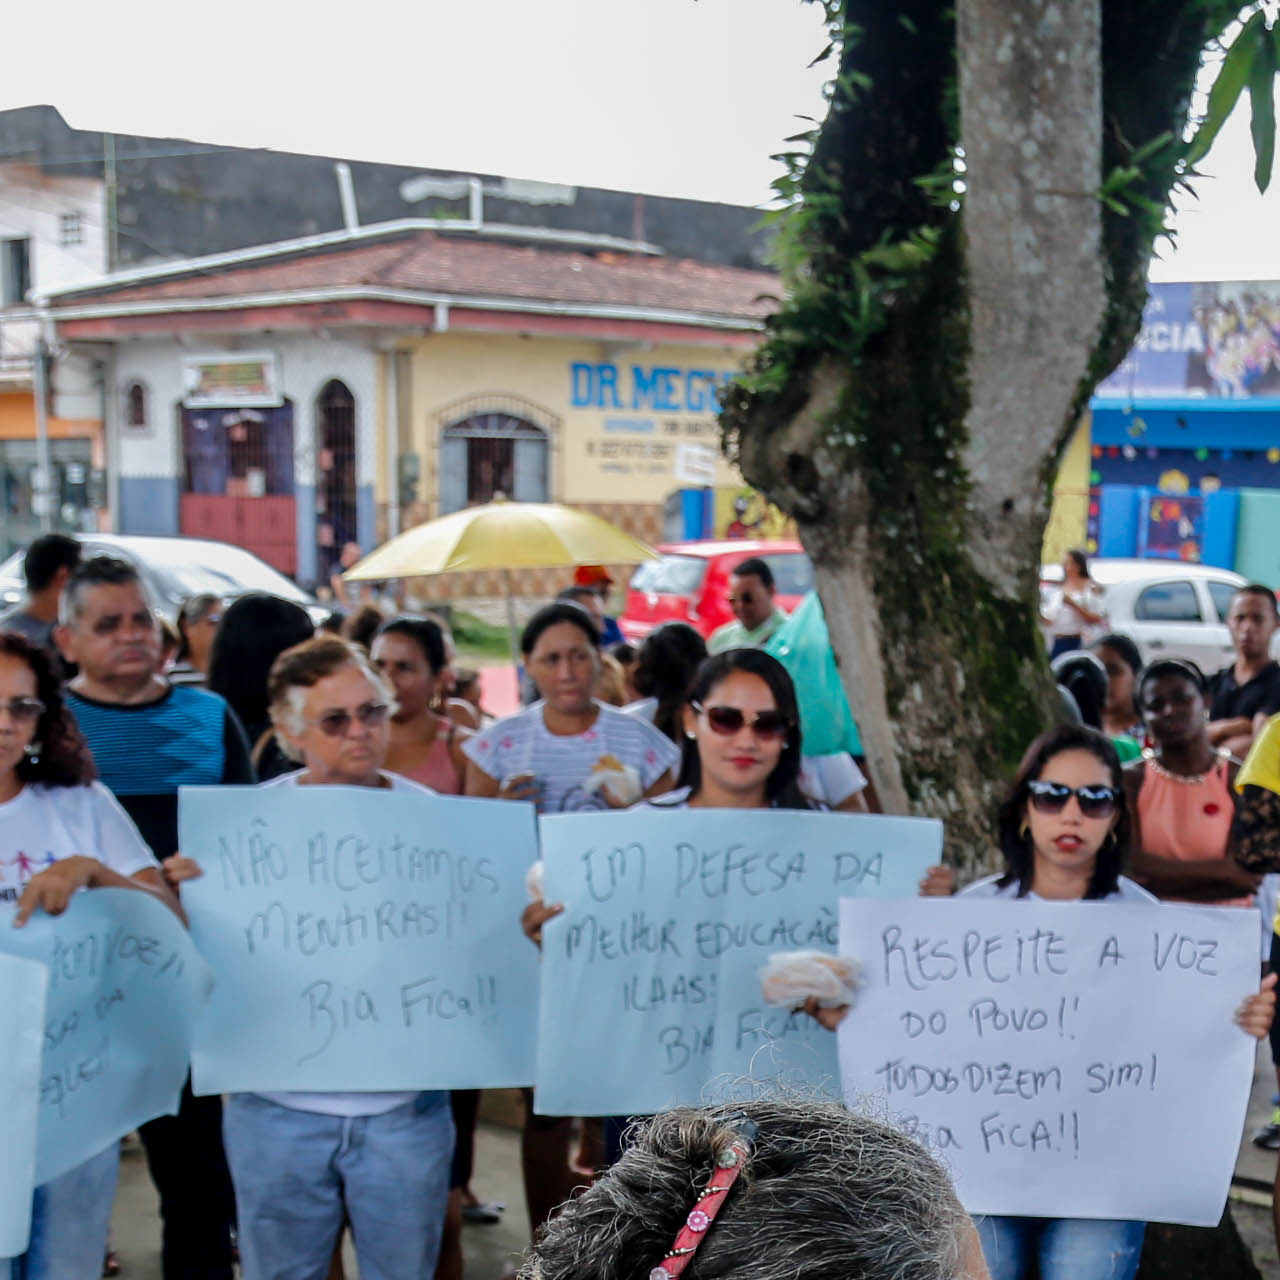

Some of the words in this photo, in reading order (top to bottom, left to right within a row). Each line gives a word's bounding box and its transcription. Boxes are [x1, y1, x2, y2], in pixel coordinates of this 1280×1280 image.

[217, 817, 288, 890] NÃO
[581, 842, 644, 902] EM
[675, 843, 807, 898] DEFESA
[834, 851, 883, 885] DA
[1098, 935, 1122, 968] A
[1153, 932, 1219, 977] VOZ
[900, 1009, 947, 1039] DO
